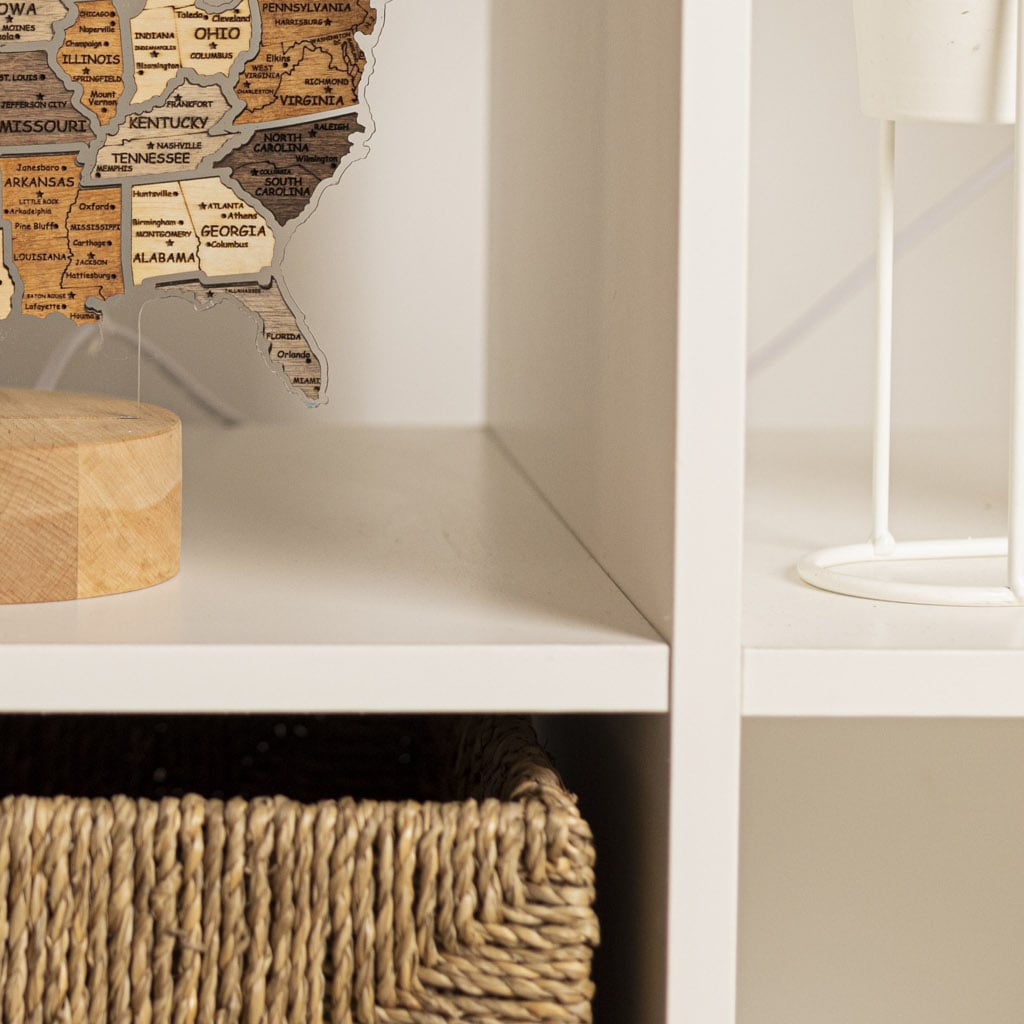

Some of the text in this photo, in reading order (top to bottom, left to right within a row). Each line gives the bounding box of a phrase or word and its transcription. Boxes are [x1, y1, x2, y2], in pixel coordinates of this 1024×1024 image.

[263, 4, 351, 12] PENNSYLVANIA
[195, 28, 240, 40] OHIO
[63, 55, 120, 64] ILLINOIS
[280, 96, 344, 105] VIRGINIA
[0, 120, 86, 133] MISSOURI
[129, 117, 208, 129] KENTUCKY
[264, 134, 302, 142] NORTH
[254, 144, 309, 152] CAROLINA
[112, 153, 190, 164] TENNESSEE
[4, 177, 75, 187] ARKANSAS
[265, 177, 302, 186] SOUTH
[256, 188, 310, 196] CAROLINA
[79, 203, 110, 211] Oxford
[201, 226, 266, 237] GEORGIA
[73, 240, 106, 248] Carthage
[133, 253, 195, 263] ALABAMA
